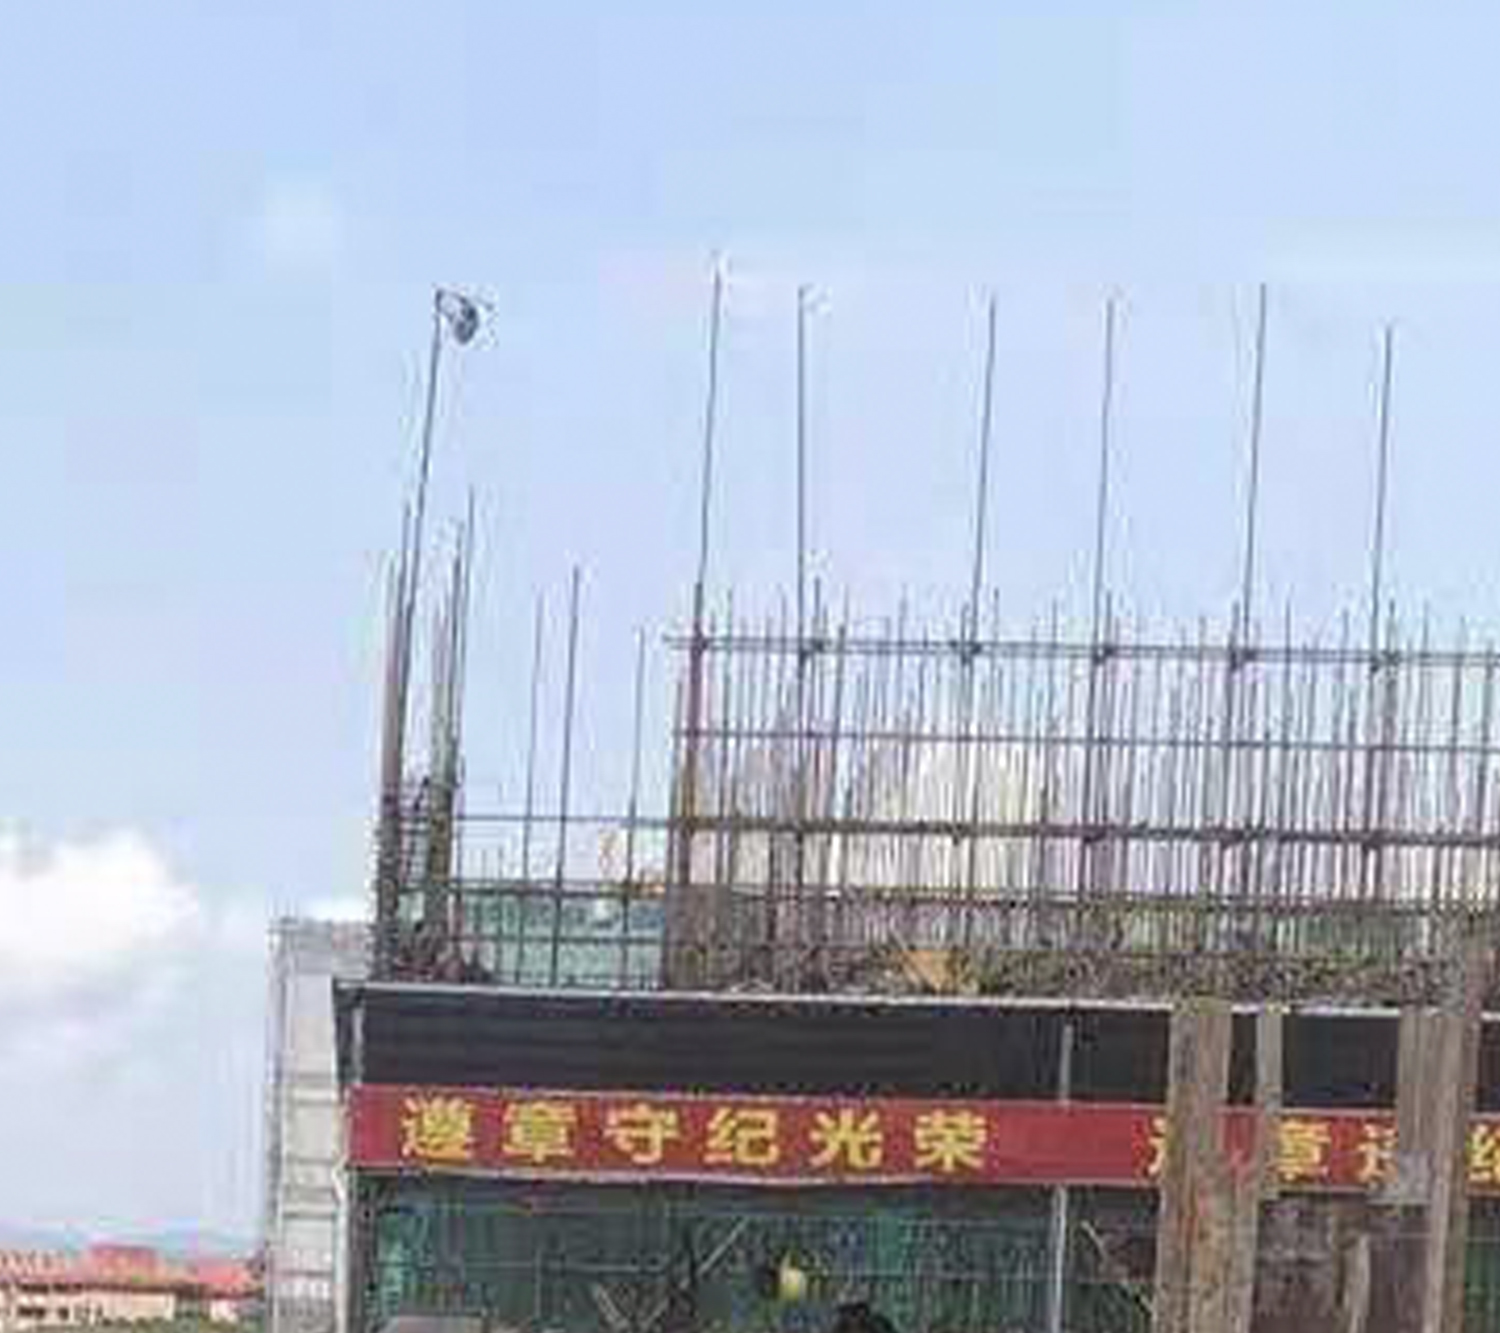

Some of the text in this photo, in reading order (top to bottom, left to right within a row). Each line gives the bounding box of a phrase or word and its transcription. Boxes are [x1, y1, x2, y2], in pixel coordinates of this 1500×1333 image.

[401, 1097, 987, 1172] 遵章守纪光荣
